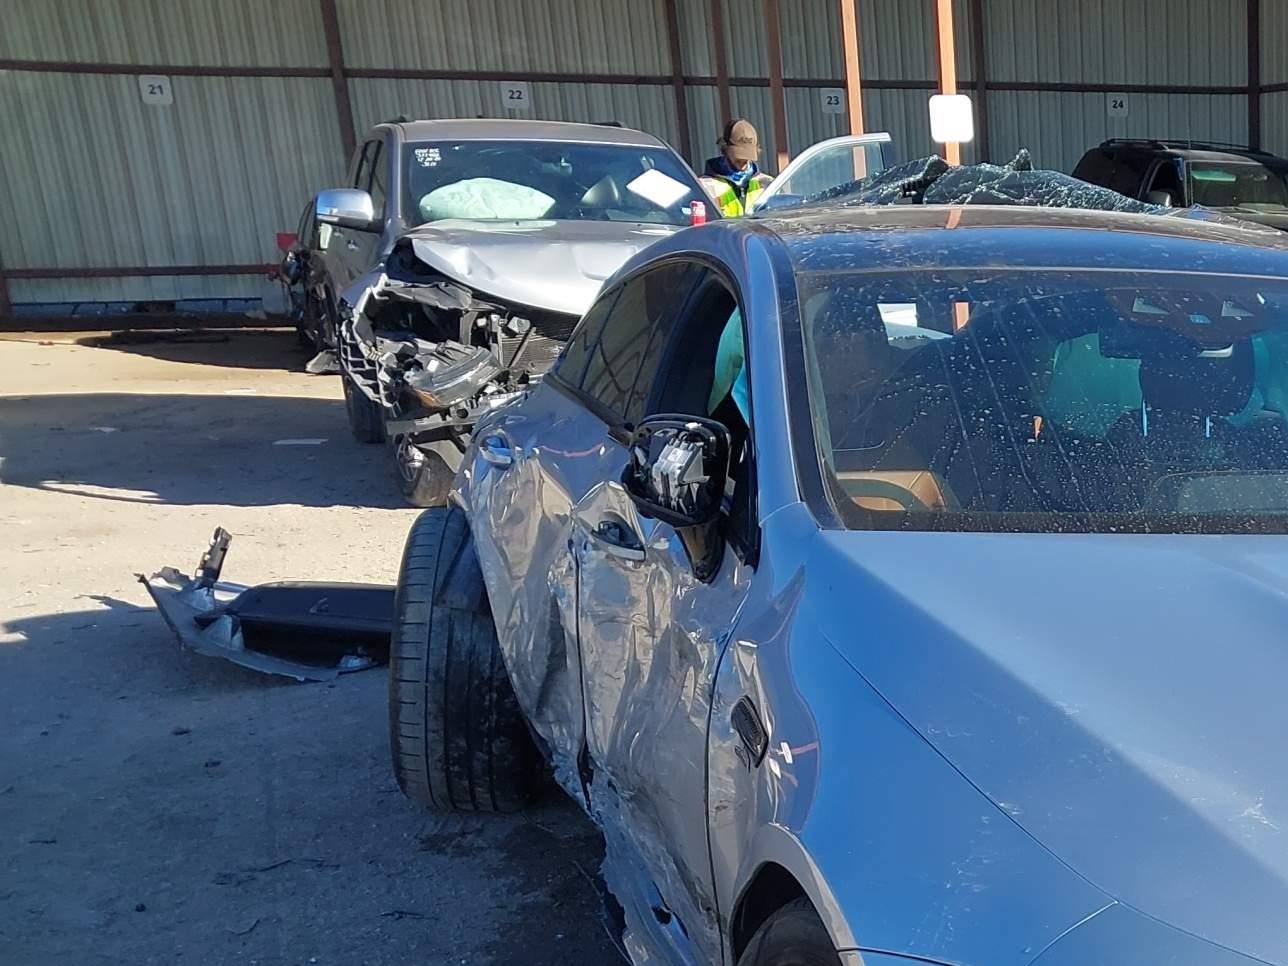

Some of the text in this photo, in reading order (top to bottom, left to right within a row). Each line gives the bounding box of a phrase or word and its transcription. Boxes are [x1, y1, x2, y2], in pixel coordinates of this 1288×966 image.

[147, 84, 164, 95] 21
[508, 89, 524, 100] 22
[826, 95, 840, 106] 23
[1111, 99, 1124, 109] 24
